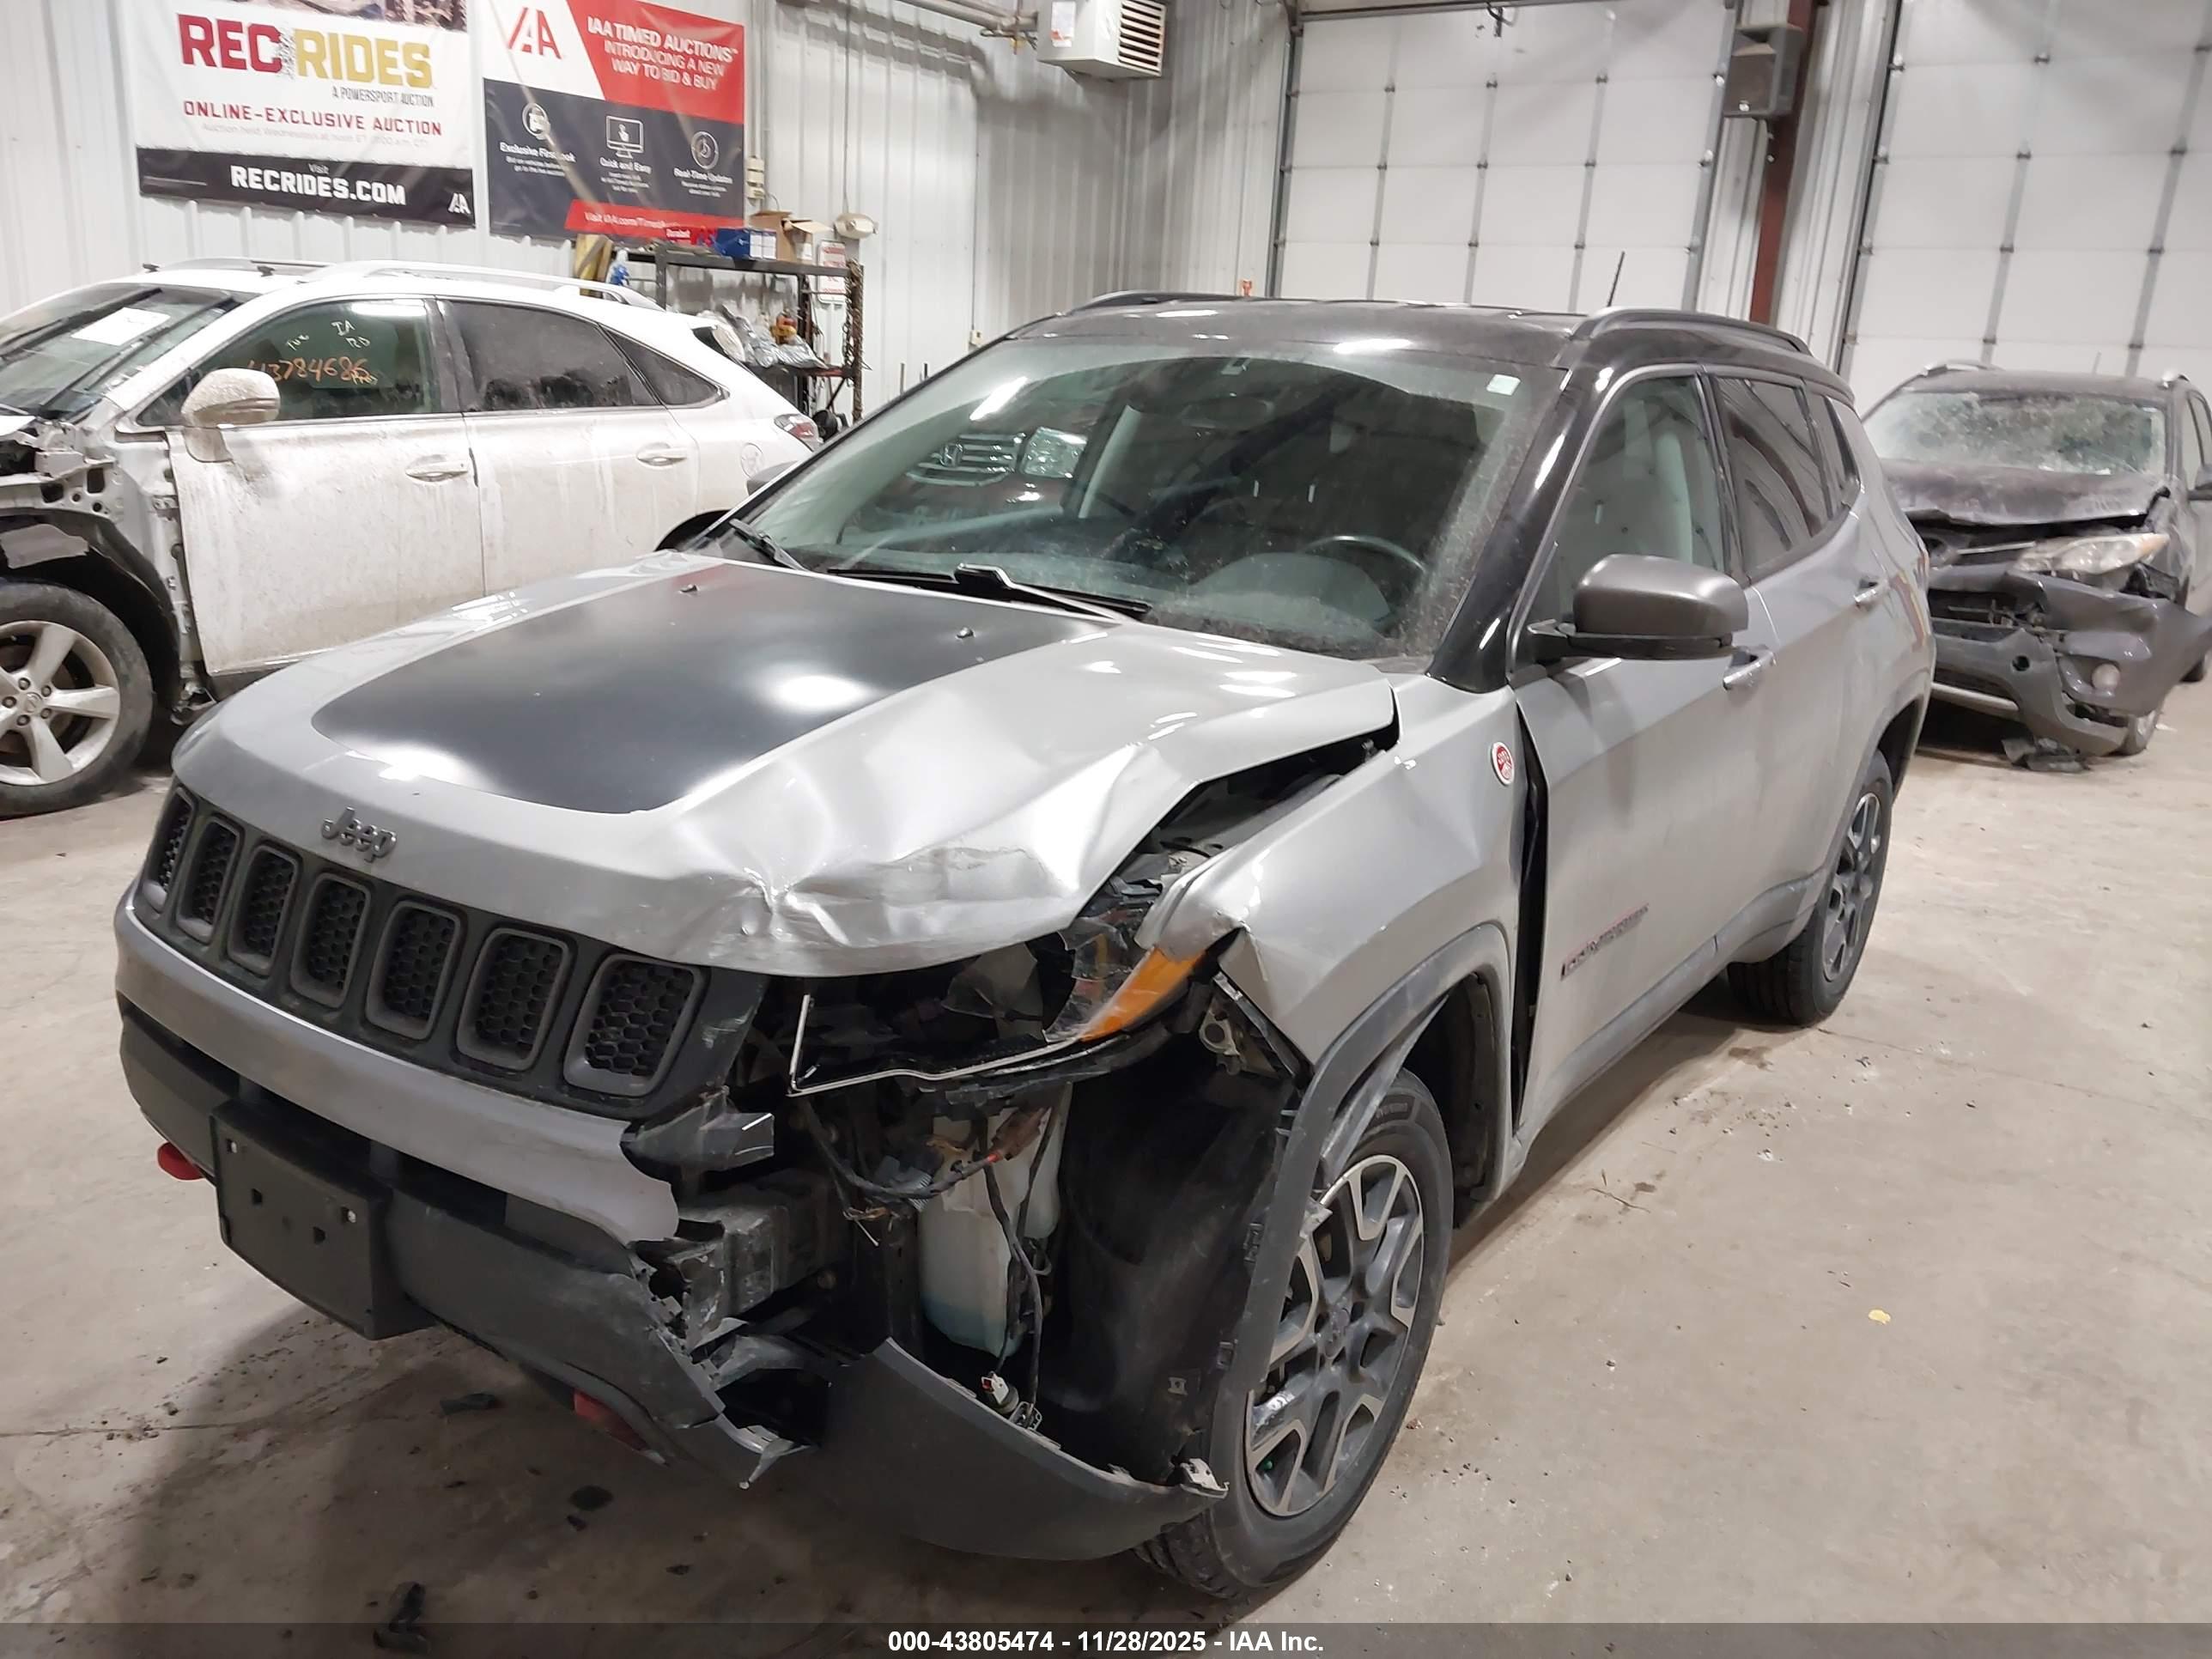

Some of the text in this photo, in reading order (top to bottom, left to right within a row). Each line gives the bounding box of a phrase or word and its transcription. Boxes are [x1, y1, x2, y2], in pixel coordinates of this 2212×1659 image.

[587, 15, 613, 39] IAA
[613, 22, 661, 48] TIMED
[177, 13, 434, 89] REC RIDES
[604, 40, 726, 76] INTRODUCING A NEW
[611, 57, 719, 91] WAY TO BID & BUY
[183, 100, 365, 130] ONLINE-EXCLUSIVE
[373, 118, 442, 137] AUCTION
[399, 93, 434, 108] AUCTION
[230, 165, 406, 206] RECRIDES.COM
[321, 806, 397, 864] Jeep
